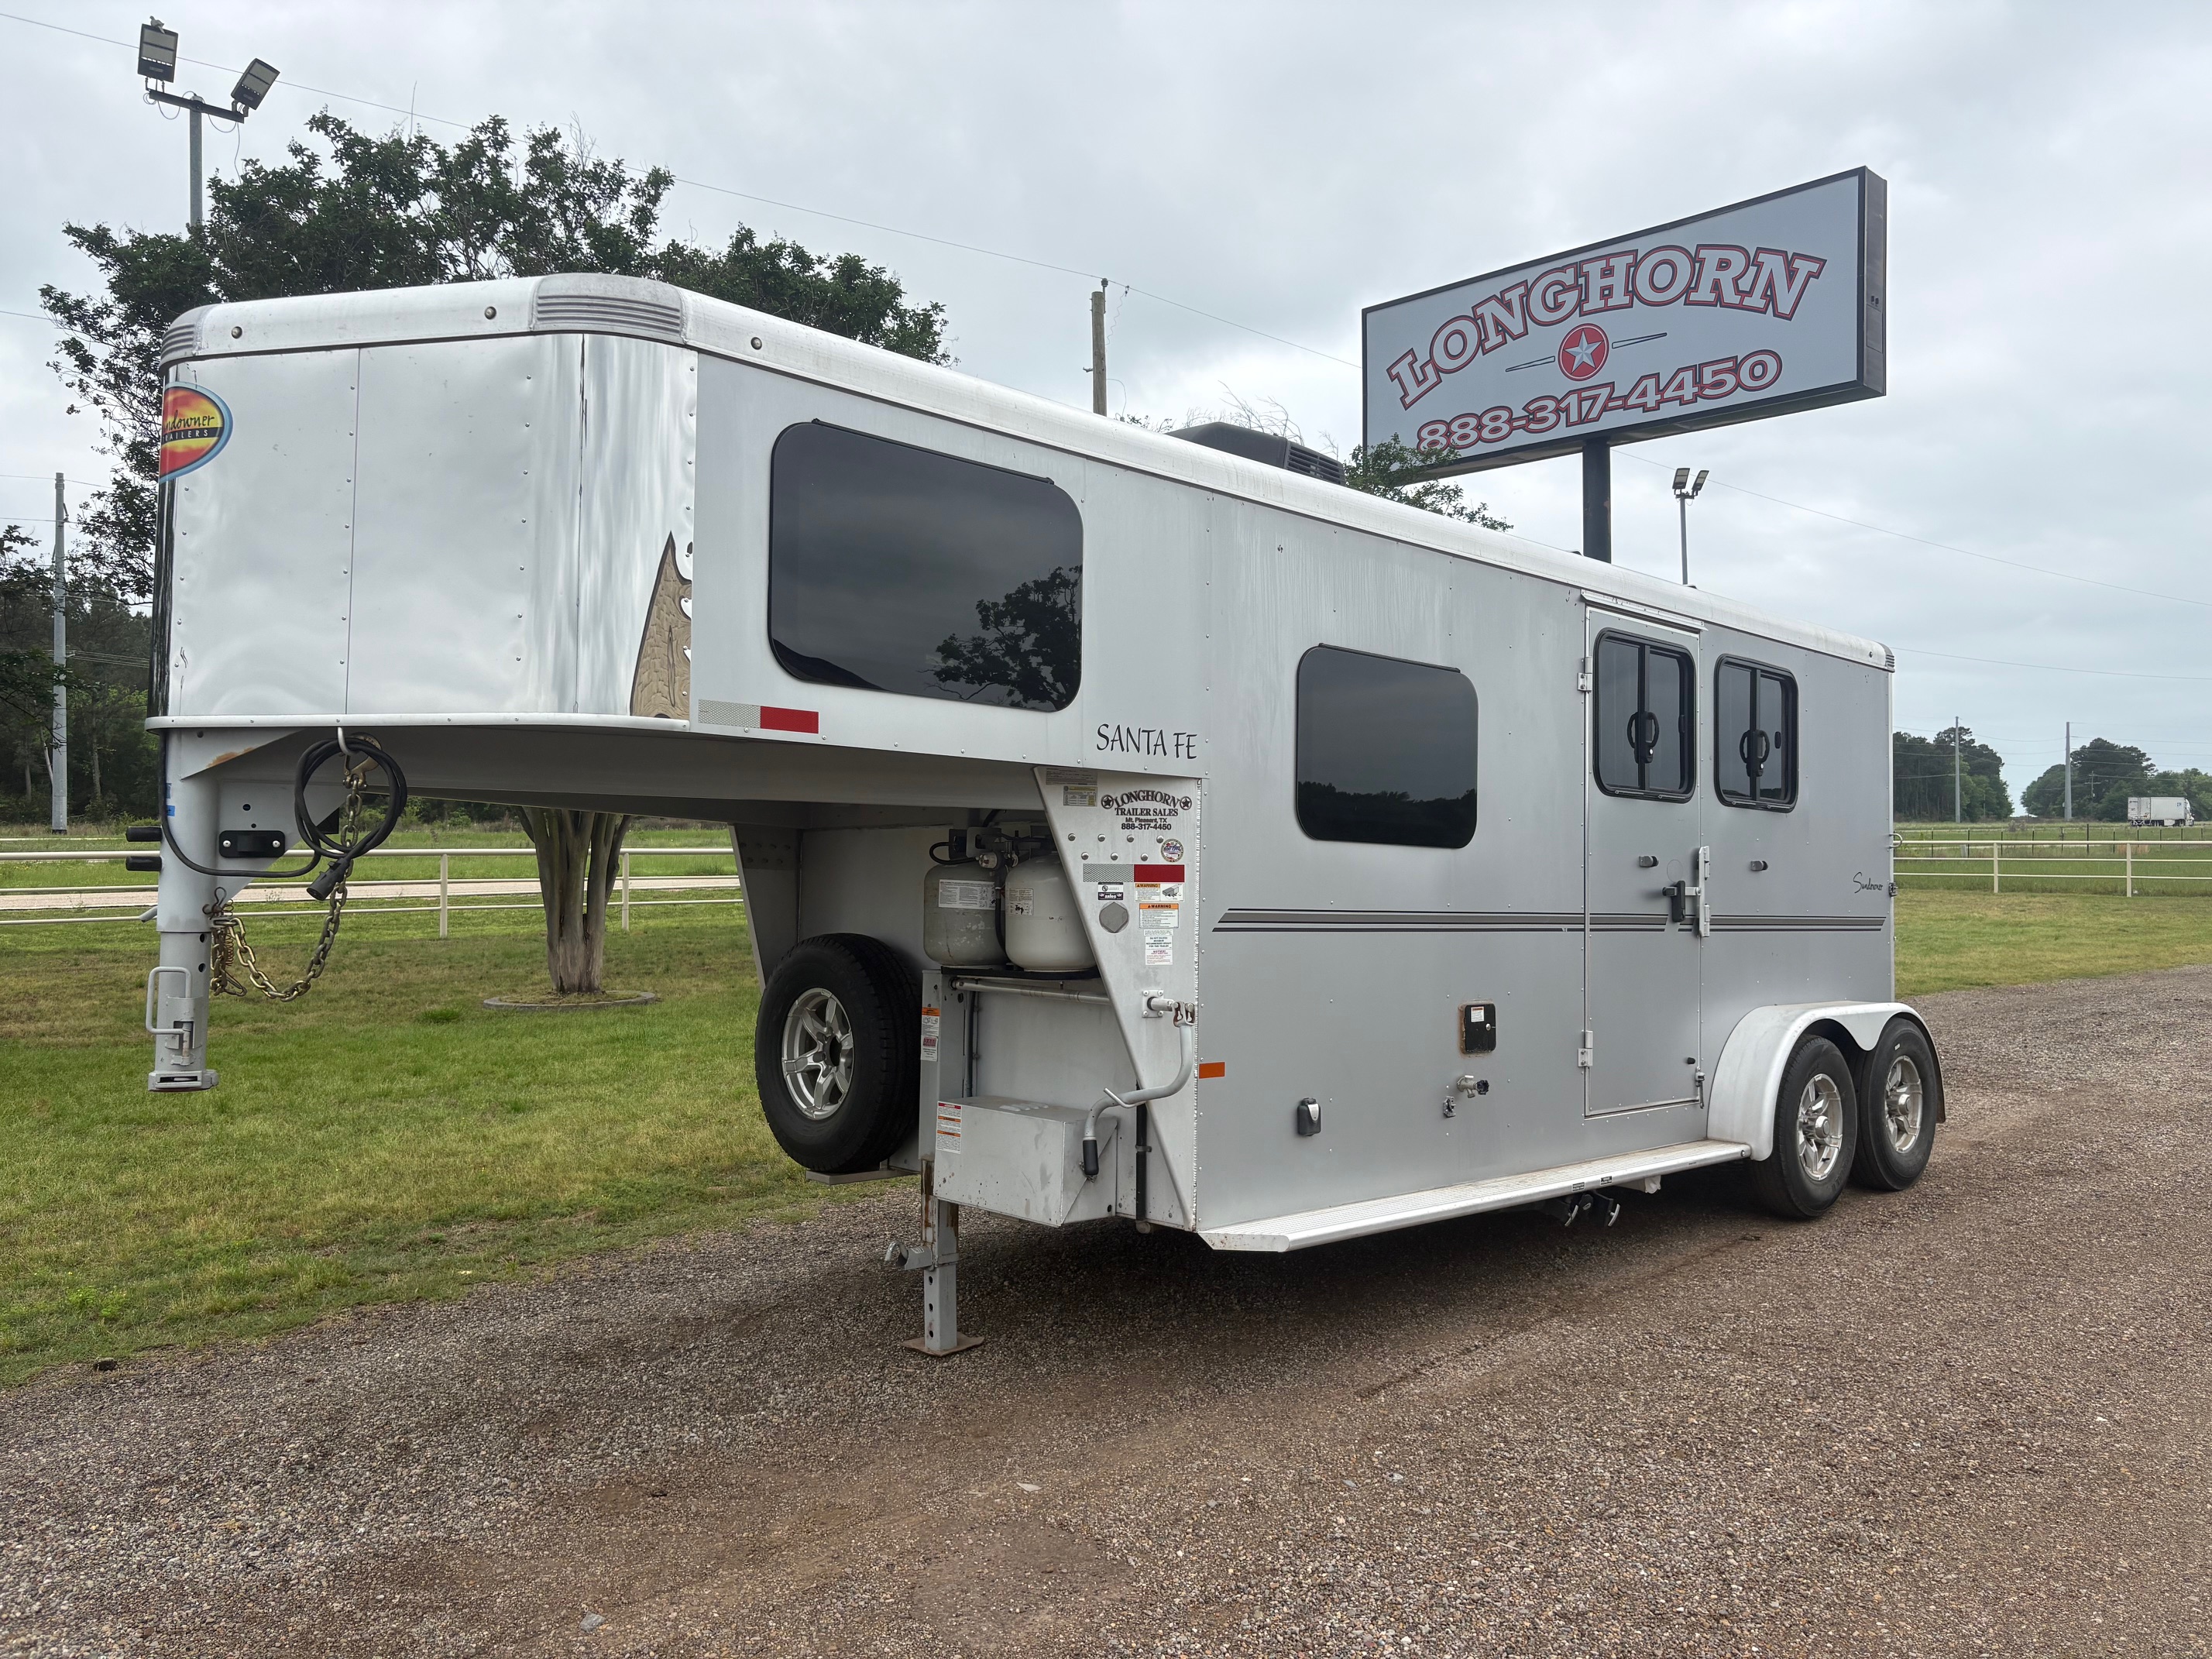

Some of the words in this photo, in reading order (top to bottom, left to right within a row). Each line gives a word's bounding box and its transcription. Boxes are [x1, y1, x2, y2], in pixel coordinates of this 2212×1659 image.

[1386, 244, 1827, 411] LONGHORN
[1417, 349, 1783, 453] 888-317-4450
[1097, 723, 1167, 757] SANTA
[1173, 732, 1197, 760] FE
[1114, 790, 1180, 809] LONGHORN
[1115, 808, 1151, 816] TRAILER
